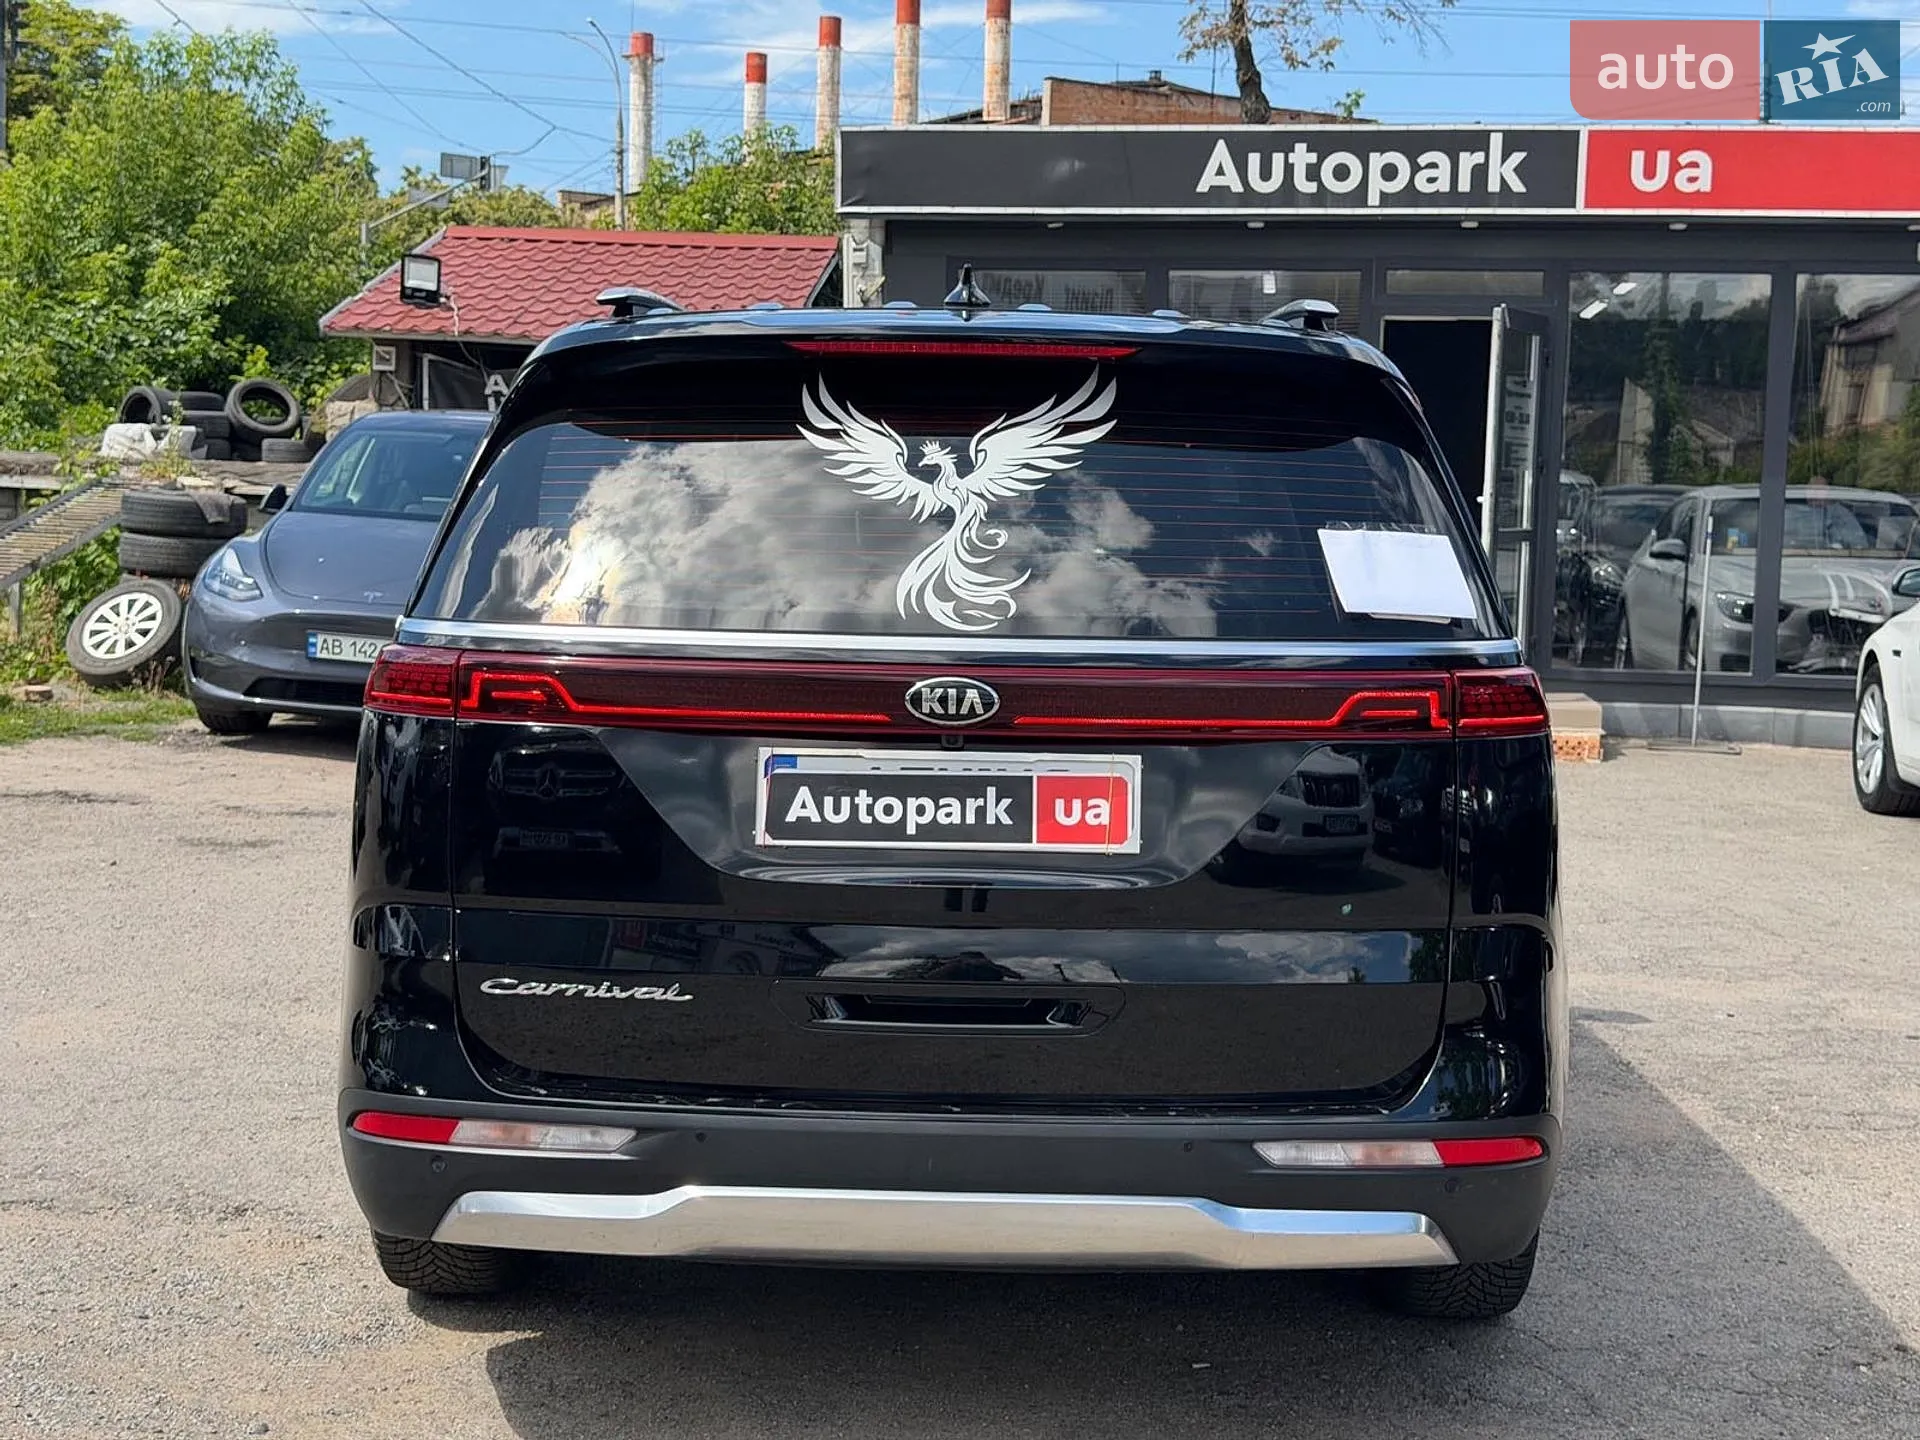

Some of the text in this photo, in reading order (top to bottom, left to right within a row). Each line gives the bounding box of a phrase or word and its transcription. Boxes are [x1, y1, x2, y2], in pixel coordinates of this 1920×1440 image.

[1195, 130, 1713, 208] Autopark ua
[320, 637, 379, 659] AB 142
[920, 686, 985, 716] KIA
[784, 785, 1112, 836] Autopark ua
[479, 977, 694, 1001] Carnival
